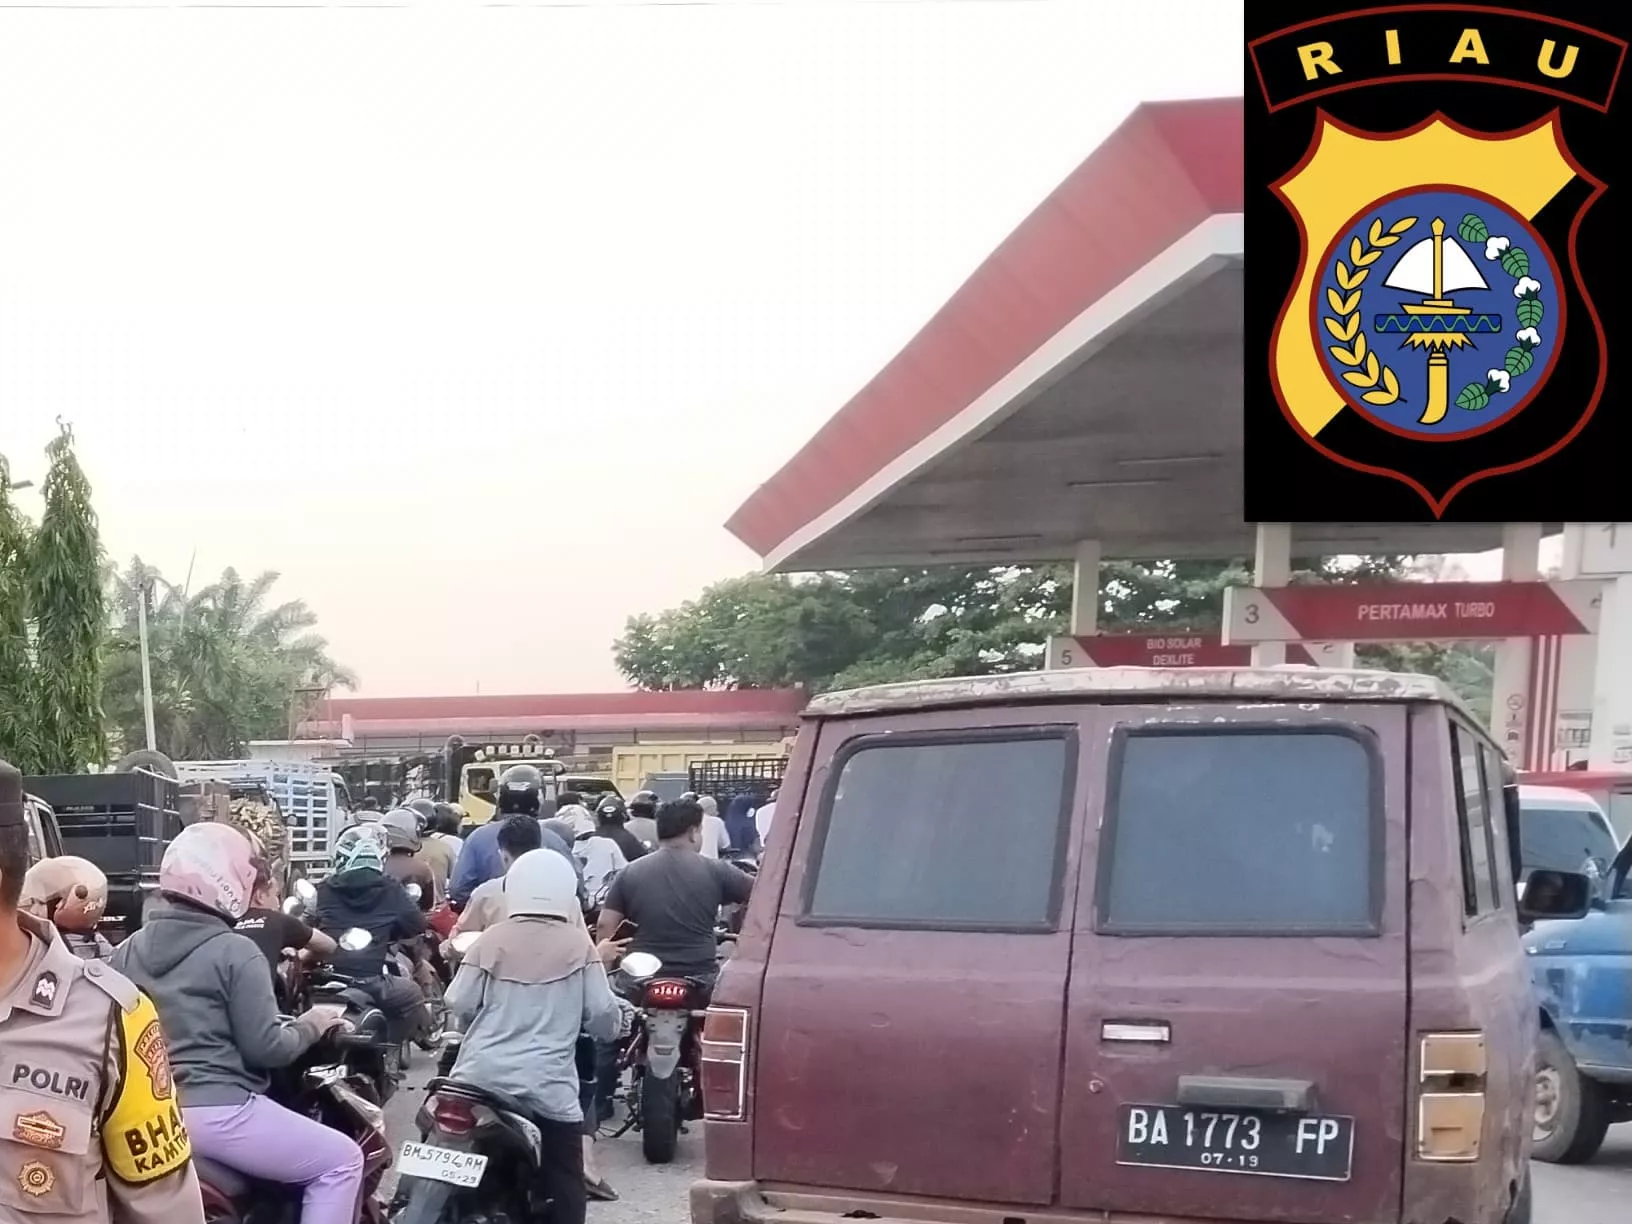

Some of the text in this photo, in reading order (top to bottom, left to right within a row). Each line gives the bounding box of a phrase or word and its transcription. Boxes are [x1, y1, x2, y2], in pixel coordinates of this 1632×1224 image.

[1244, 601, 1496, 624] 3 PERTAMAX TURBO
[1146, 637, 1202, 649] BIO SOLAR
[1061, 649, 1073, 666] 5
[1152, 653, 1195, 665] DEXLITE
[12, 1062, 90, 1100] POLRI
[1128, 1108, 1340, 1155] BA 1773 FP
[403, 1144, 421, 1161] BM
